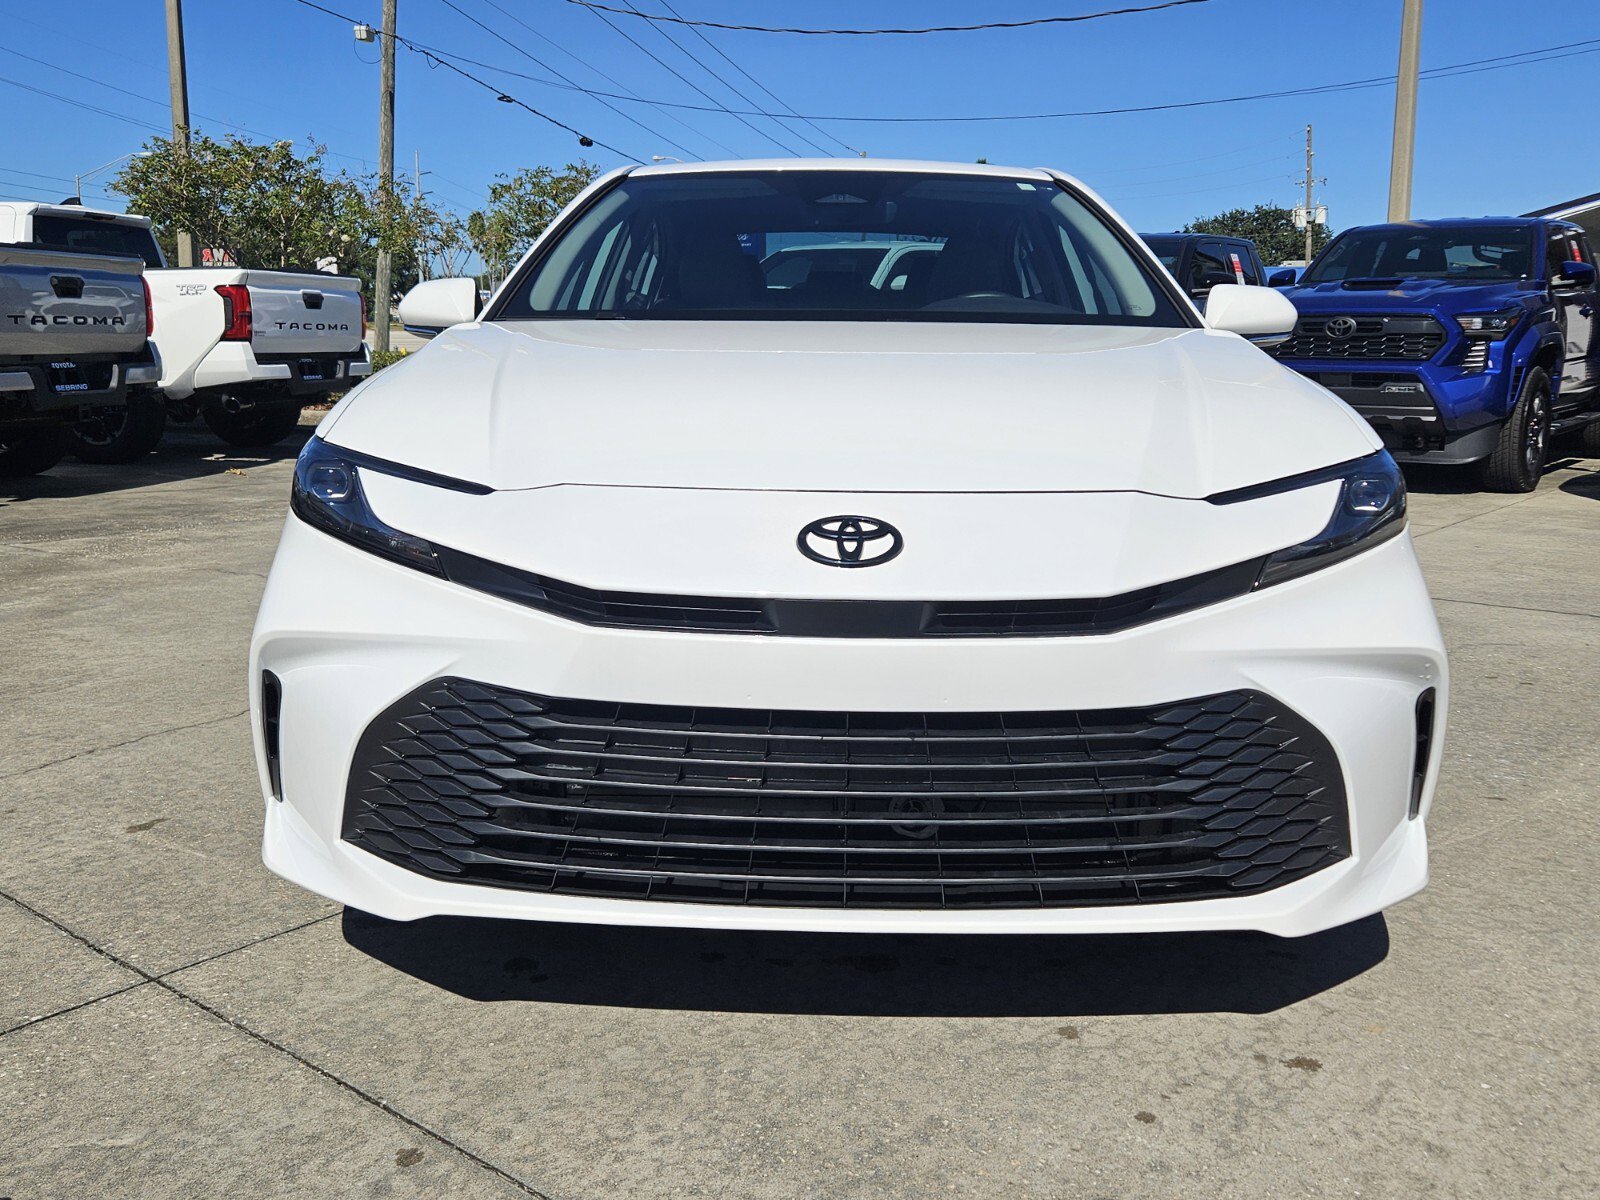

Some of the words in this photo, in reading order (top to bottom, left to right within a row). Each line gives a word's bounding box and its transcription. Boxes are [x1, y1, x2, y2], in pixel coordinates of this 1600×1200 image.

[7, 314, 125, 326] TACOMA
[274, 322, 349, 331] TACOMA
[55, 383, 88, 391] SEBRING
